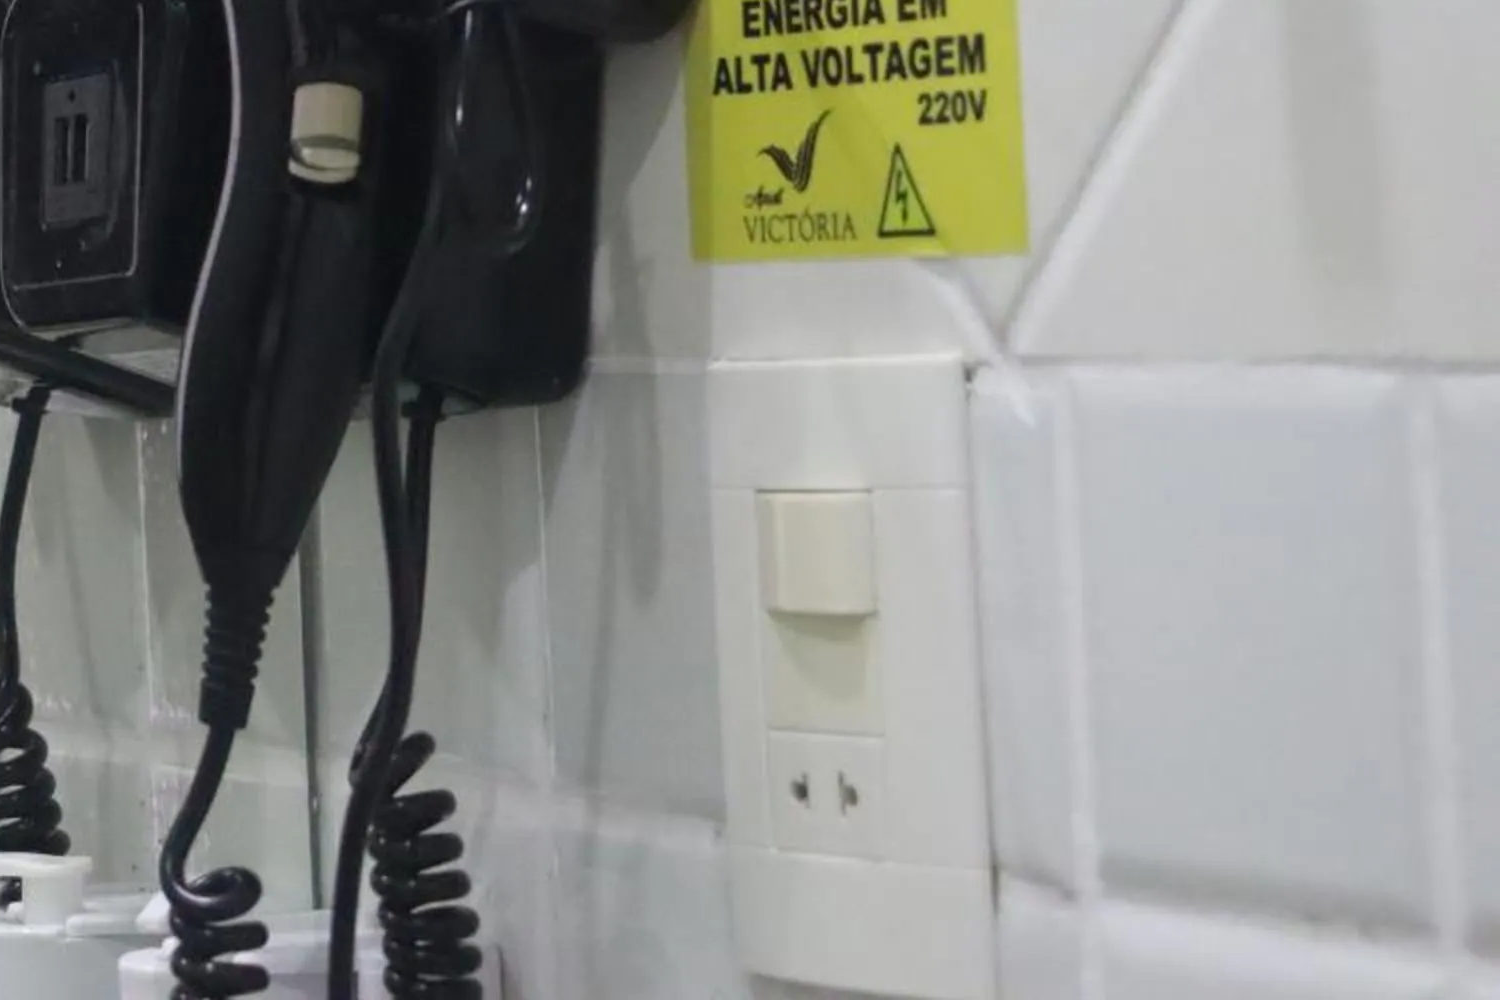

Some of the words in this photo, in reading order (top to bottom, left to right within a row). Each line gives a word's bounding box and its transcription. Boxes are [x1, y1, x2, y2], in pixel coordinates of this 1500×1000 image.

[712, 52, 793, 95] ALTA
[801, 33, 986, 88] VOLTAGEM
[917, 89, 987, 126] 220V
[743, 208, 858, 243] VICTÓRIA
